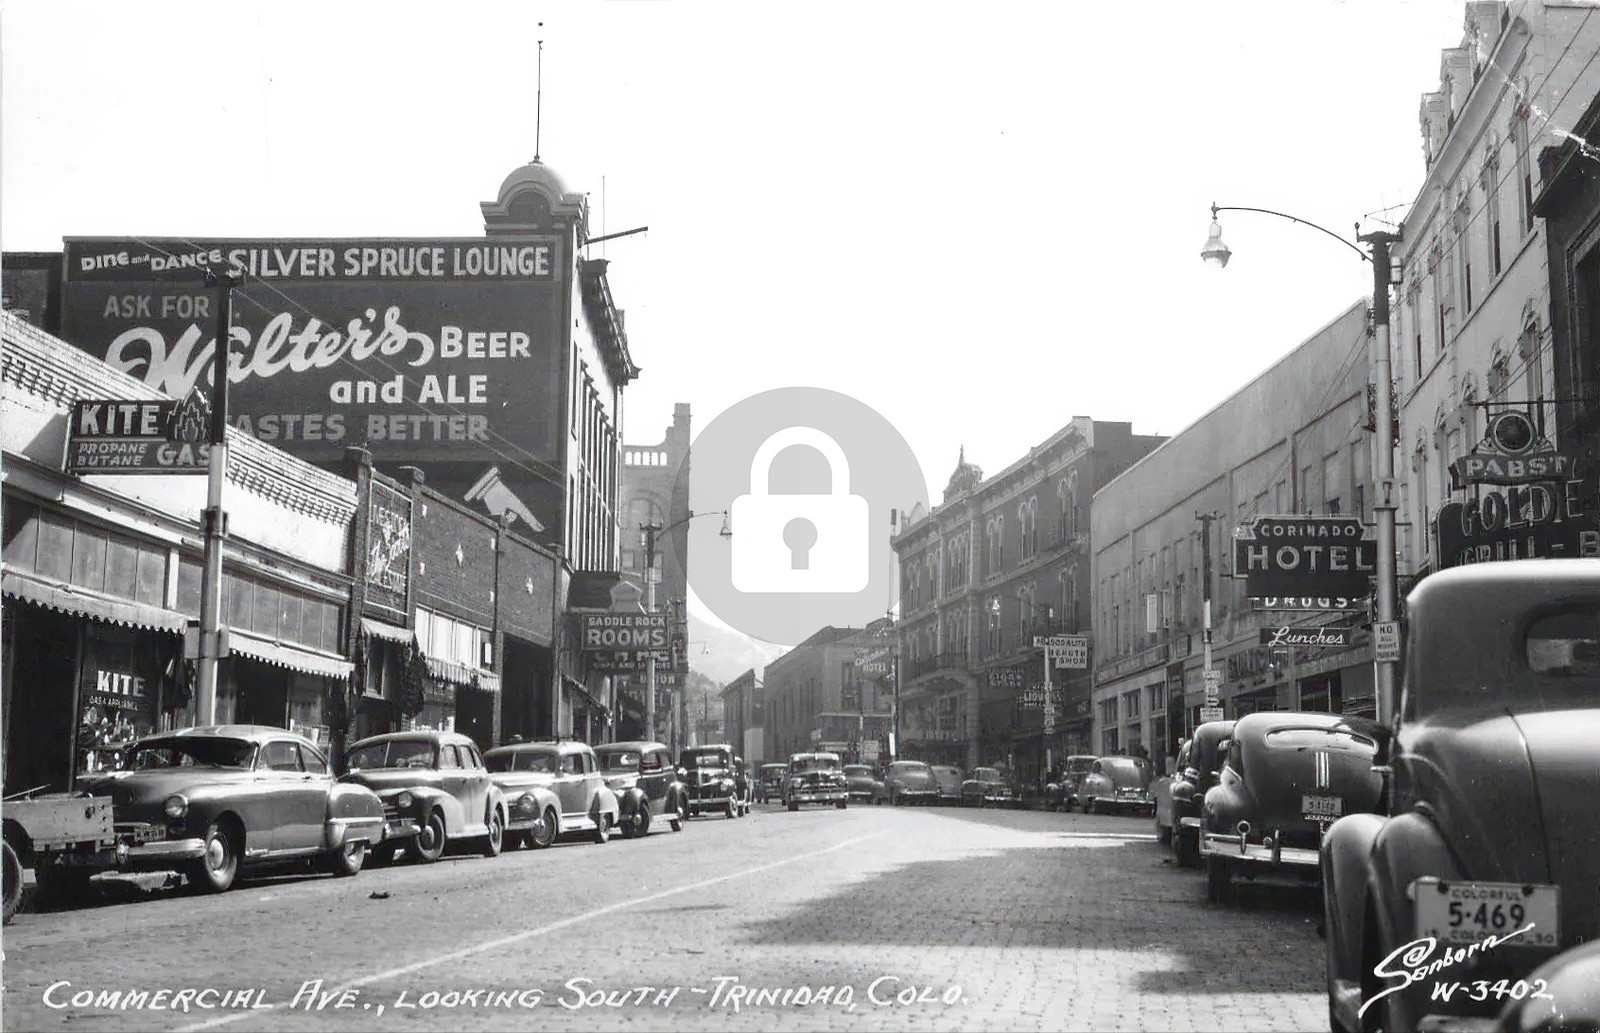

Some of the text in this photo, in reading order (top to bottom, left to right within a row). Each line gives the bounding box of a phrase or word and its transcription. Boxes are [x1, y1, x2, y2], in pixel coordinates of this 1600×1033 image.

[151, 249, 222, 271] DANCE
[226, 247, 336, 278] SILVER
[343, 247, 445, 277] SPRUCE
[452, 246, 549, 276] LOUNGE
[103, 295, 211, 319] ASK FOR
[441, 325, 531, 358] BEER
[329, 375, 488, 404] and ALE
[80, 404, 160, 435] KITE
[227, 414, 490, 442] ASTES BETTER
[77, 455, 143, 466] BUTANE
[78, 443, 148, 454] PROPANE
[1466, 456, 1568, 478] PABST
[1247, 545, 1373, 571] HOTEL
[588, 616, 665, 627] SADDLE ROCK
[587, 628, 664, 647] ROOMS
[1268, 626, 1345, 647] Lunches
[97, 670, 146, 697] KITE
